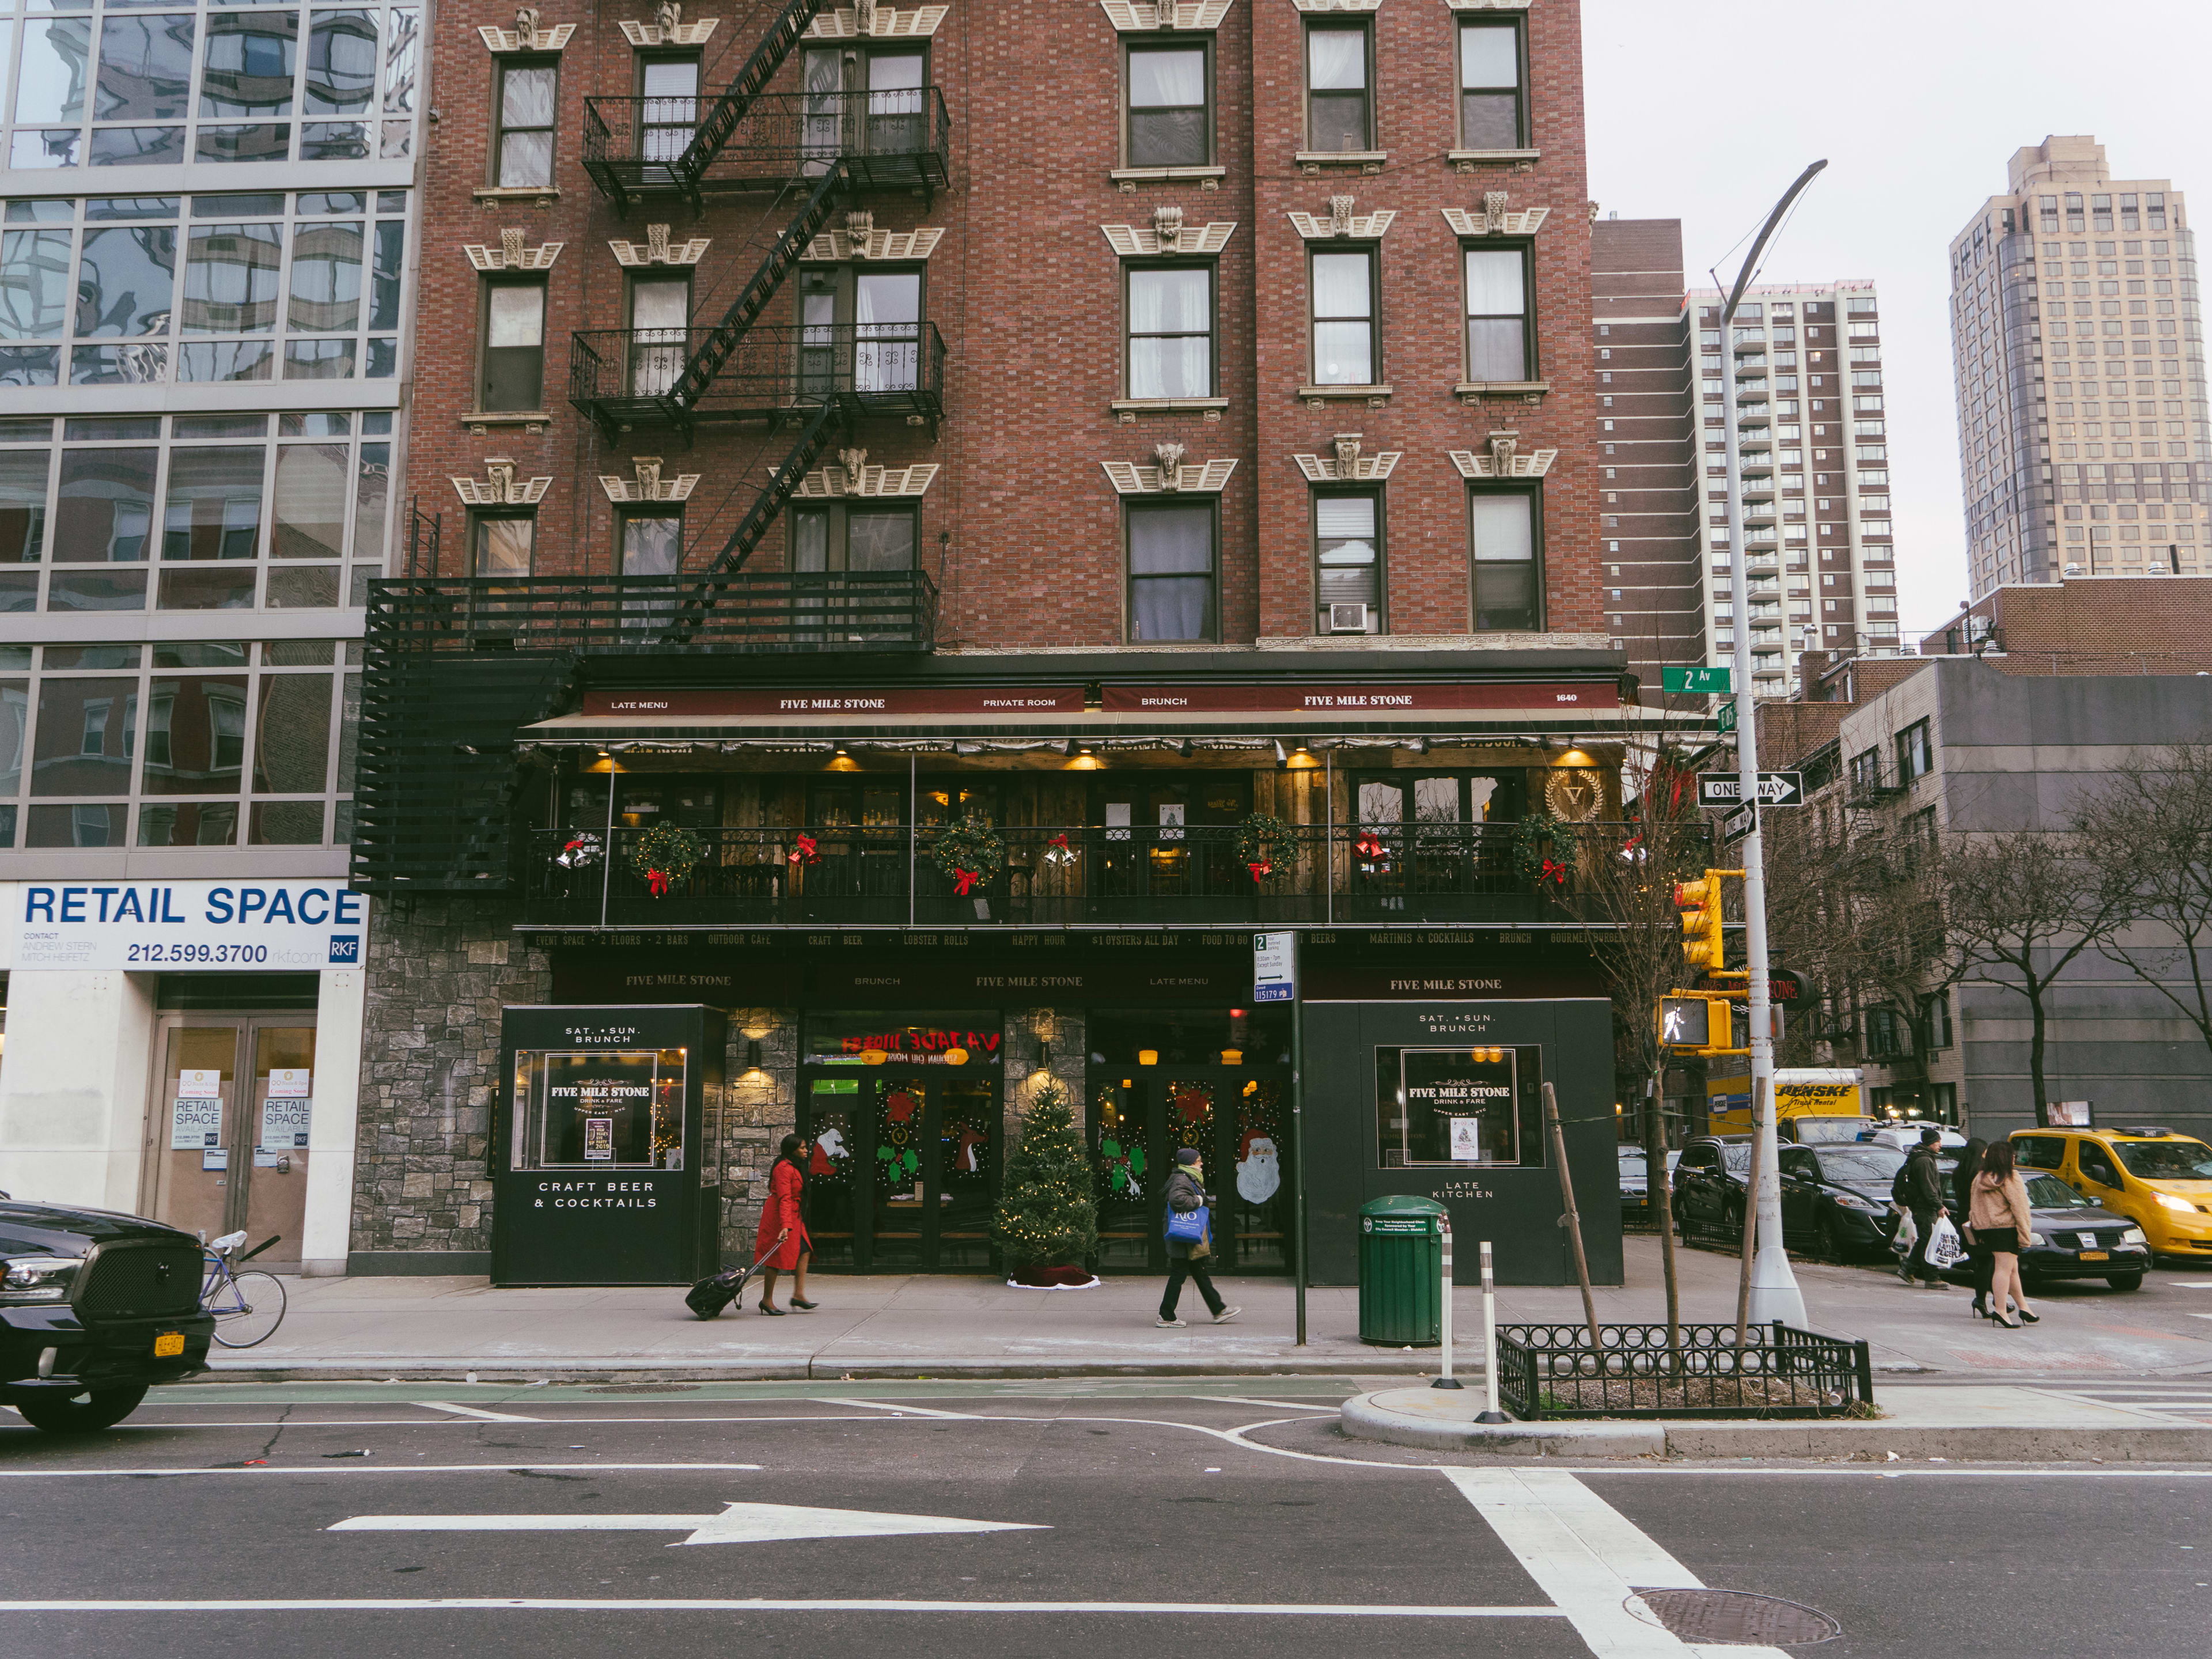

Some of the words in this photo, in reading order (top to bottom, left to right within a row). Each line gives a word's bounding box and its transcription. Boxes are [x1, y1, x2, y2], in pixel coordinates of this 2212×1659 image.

[1684, 671, 1694, 690] 2
[1699, 670, 1710, 681] Av
[780, 699, 808, 709] FIVE
[811, 699, 841, 708] MILE
[844, 699, 885, 708] STONE
[1304, 696, 1333, 706] FIVE
[1336, 695, 1367, 705] MILE
[1370, 695, 1412, 705] STONE
[1713, 783, 1740, 796] ONE
[1727, 819, 1736, 835] ONE
[1740, 812, 1750, 827] WAY
[25, 888, 185, 922] RETAIL
[205, 888, 362, 925] SPACE
[536, 935, 558, 945] EVENT
[563, 935, 585, 945] SPACE
[601, 935, 606, 944] 2
[611, 935, 641, 945] FLOORS
[656, 935, 661, 944] 2
[667, 935, 688, 945] BARS
[708, 934, 745, 944] OUTDOOR
[808, 935, 831, 945] CRAFT
[843, 935, 863, 945] BEER
[904, 935, 937, 945] LOBSTER
[944, 935, 968, 945] ROLLS
[1012, 935, 1038, 945] HAPPY
[1044, 935, 1066, 945] HOUR
[1092, 935, 1103, 945] $1
[1106, 935, 1142, 945] OYSTERS
[1145, 935, 1159, 945] ALL
[1162, 935, 1179, 945] DAY
[1202, 935, 1222, 945] FOOD
[1225, 935, 1234, 945] TO
[1237, 935, 1248, 945] GO
[1257, 937, 1264, 949] 2
[1312, 933, 1336, 943] BEERS
[1370, 933, 1412, 943] MARTINIS
[1417, 935, 1423, 943] &
[1428, 933, 1474, 943] COCKTAILS
[1499, 933, 1532, 943] BRUNCH
[22, 942, 65, 950] ANDREW
[66, 942, 97, 950] STERN
[331, 942, 357, 956] RKF
[21, 953, 51, 961] MITCH
[128, 944, 267, 963] 212.599.3700
[272, 949, 323, 964] rkf.com
[626, 975, 653, 986] FIVE
[657, 975, 686, 984] MILE
[690, 975, 732, 986] STONE
[976, 977, 1004, 987] FIVE
[1008, 977, 1037, 987] MILE
[1041, 977, 1083, 987] STONE
[1391, 980, 1419, 990] FIVE
[1423, 980, 1455, 990] MILE
[1459, 979, 1502, 990] STONE
[1256, 990, 1277, 1000] 115179
[551, 1087, 578, 1097] FIVE
[581, 1087, 608, 1097] MILE
[611, 1087, 649, 1097] STONE
[1409, 1088, 1436, 1097] FIVE
[1439, 1088, 1468, 1097] MILE
[1470, 1087, 1510, 1097] STONE
[1778, 1085, 1853, 1097] PENSKE
[176, 1101, 219, 1112] RETAIL
[266, 1101, 309, 1112] RETAIL
[1714, 1099, 1727, 1108] PENSKE
[175, 1113, 219, 1124] SPACE
[265, 1113, 309, 1124] SPACE
[539, 1183, 596, 1191] CRAFT
[607, 1183, 653, 1191] BEER
[535, 1199, 544, 1207] &
[555, 1199, 656, 1207] COCKTAILS
